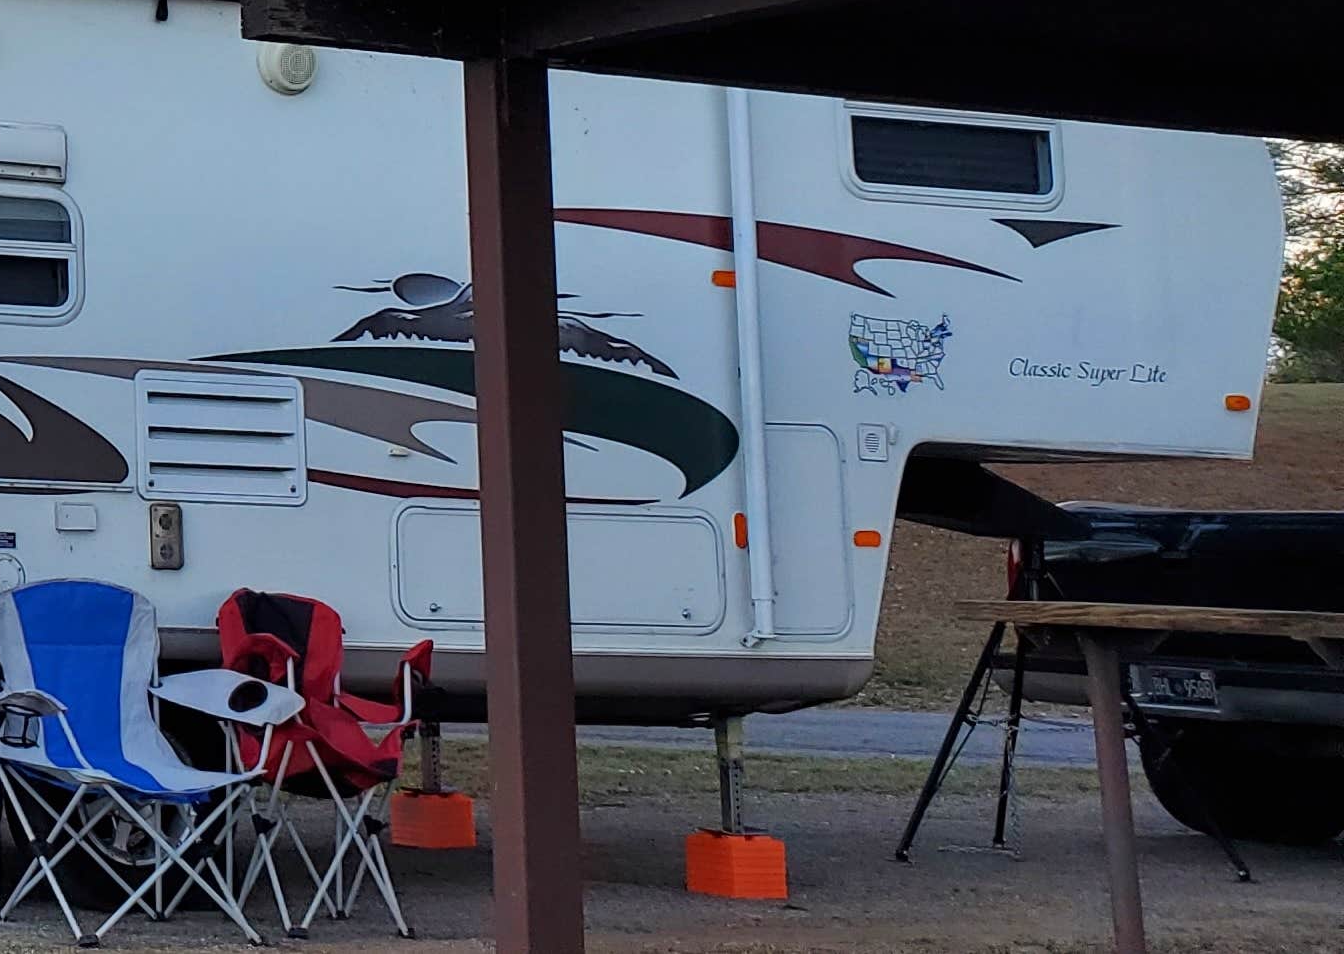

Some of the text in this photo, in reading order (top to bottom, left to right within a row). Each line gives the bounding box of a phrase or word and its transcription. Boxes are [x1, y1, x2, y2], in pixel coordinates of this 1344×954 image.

[1009, 357, 1167, 387] Classic Super Lite
